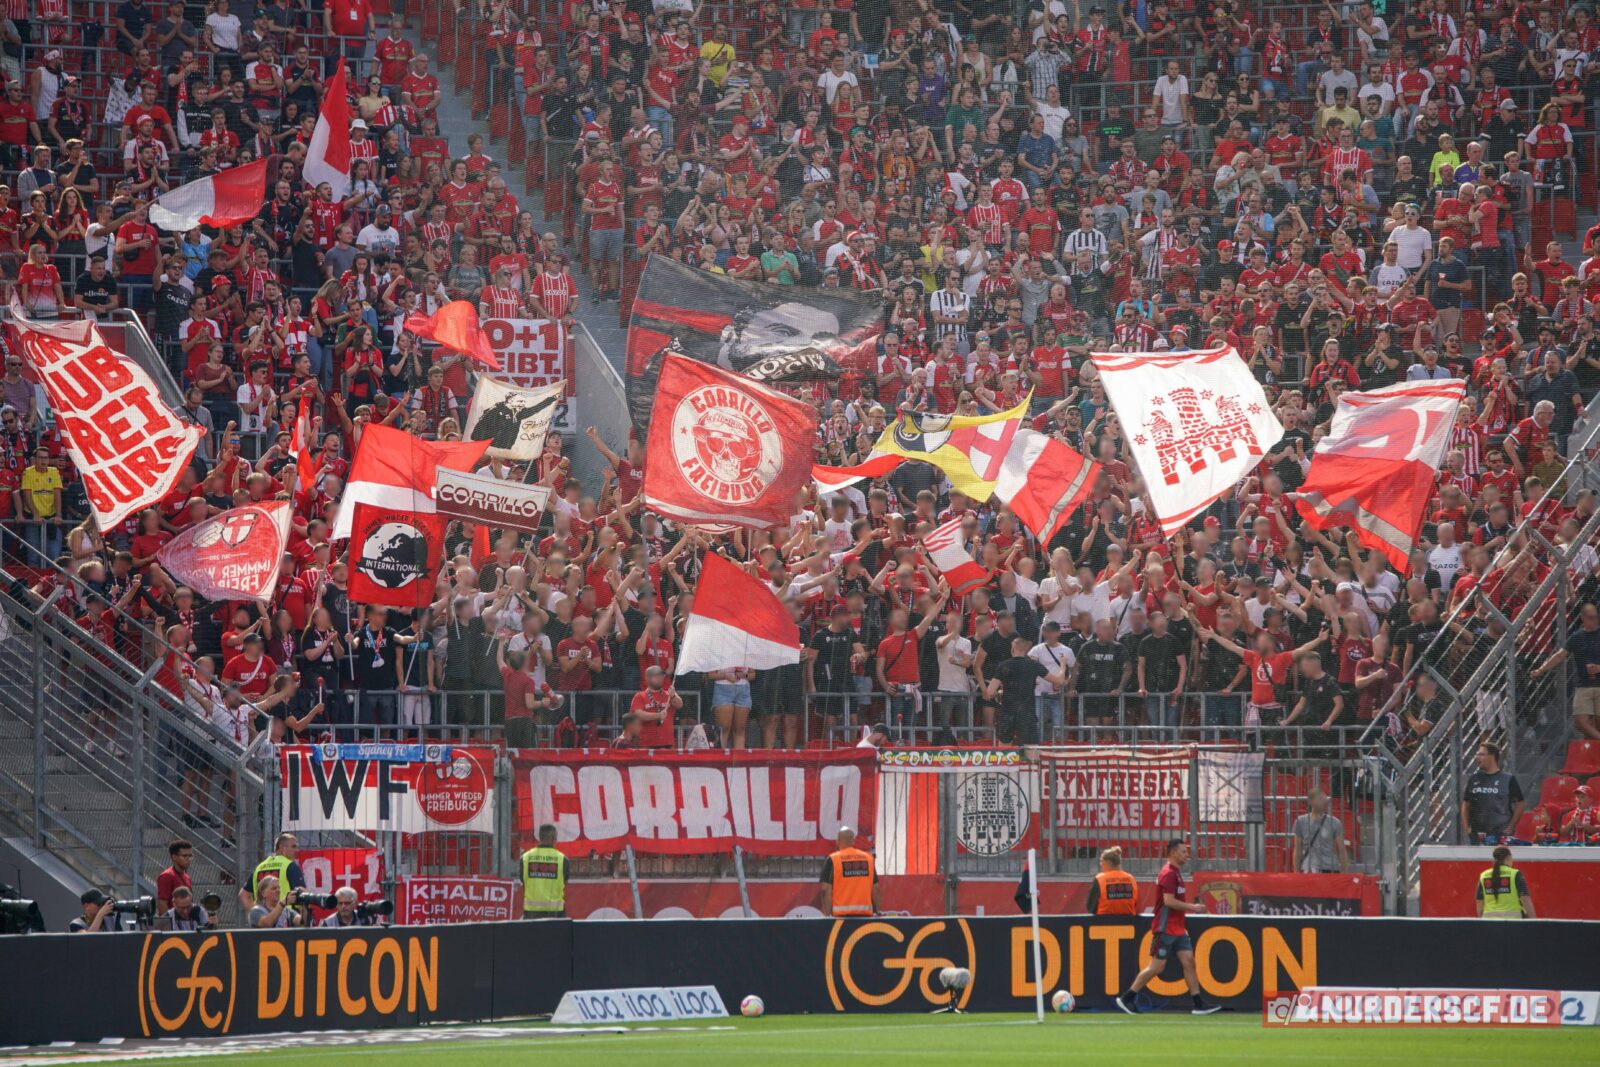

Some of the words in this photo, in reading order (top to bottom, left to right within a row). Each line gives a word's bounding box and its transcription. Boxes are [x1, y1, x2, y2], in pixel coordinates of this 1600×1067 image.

[440, 484, 538, 518] CORRILLO
[365, 559, 420, 572] INTERNATIONAL
[358, 744, 392, 759] Sydney
[394, 744, 408, 757] FC
[958, 751, 1018, 766] VOLTS
[286, 751, 410, 821] IWF
[453, 791, 483, 801] WIEDER
[426, 800, 477, 812] FREIBURG
[530, 765, 862, 842] CORRILLO
[1152, 802, 1180, 826] 79
[412, 884, 508, 902] KHALID
[411, 901, 445, 915] FÜR
[451, 904, 508, 918] IMMER
[1011, 925, 1318, 998] DITCON
[257, 936, 439, 1019] DITCON
[670, 989, 723, 1015] iLOQ
